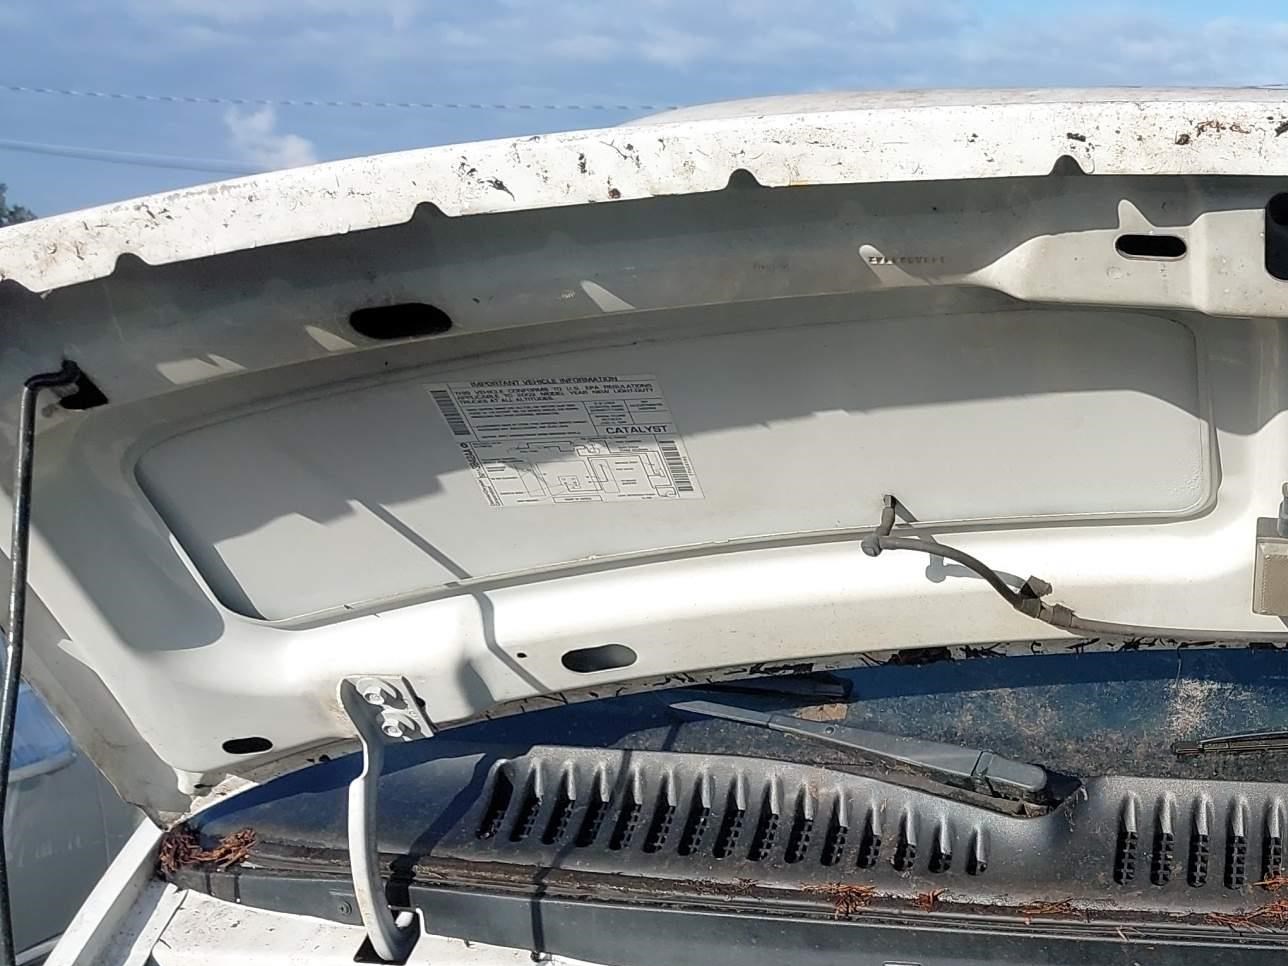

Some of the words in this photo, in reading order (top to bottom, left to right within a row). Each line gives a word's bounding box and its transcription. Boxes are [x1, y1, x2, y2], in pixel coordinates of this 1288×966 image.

[521, 378, 556, 387] VEHICLE
[558, 376, 618, 385] INFORMATION
[605, 424, 668, 435] CATALYST
